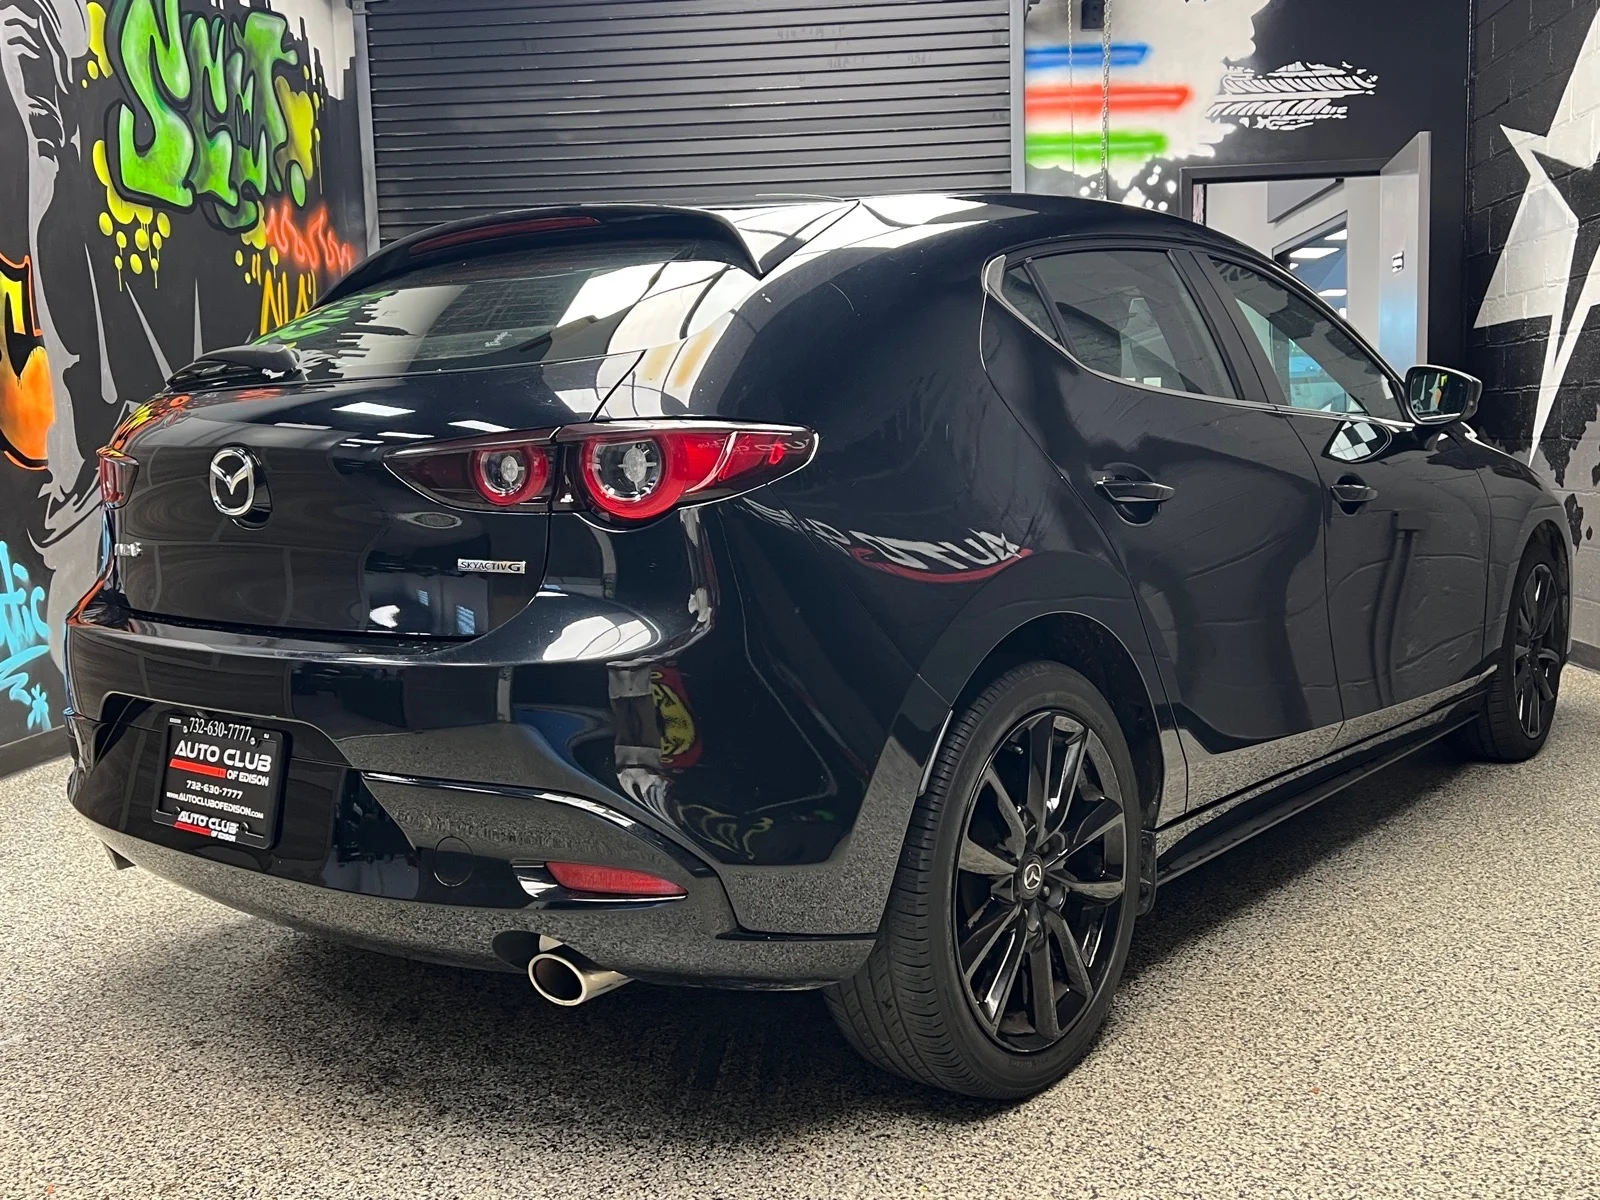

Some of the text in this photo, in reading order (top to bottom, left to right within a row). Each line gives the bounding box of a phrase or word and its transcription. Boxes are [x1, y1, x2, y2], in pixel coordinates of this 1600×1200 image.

[189, 717, 252, 742] 732-630-7777
[174, 740, 272, 772] AUTO CLUB
[186, 780, 243, 799] 732-630-7777
[226, 770, 269, 787] OF EDISON
[177, 811, 239, 834] AUTO CLUB
